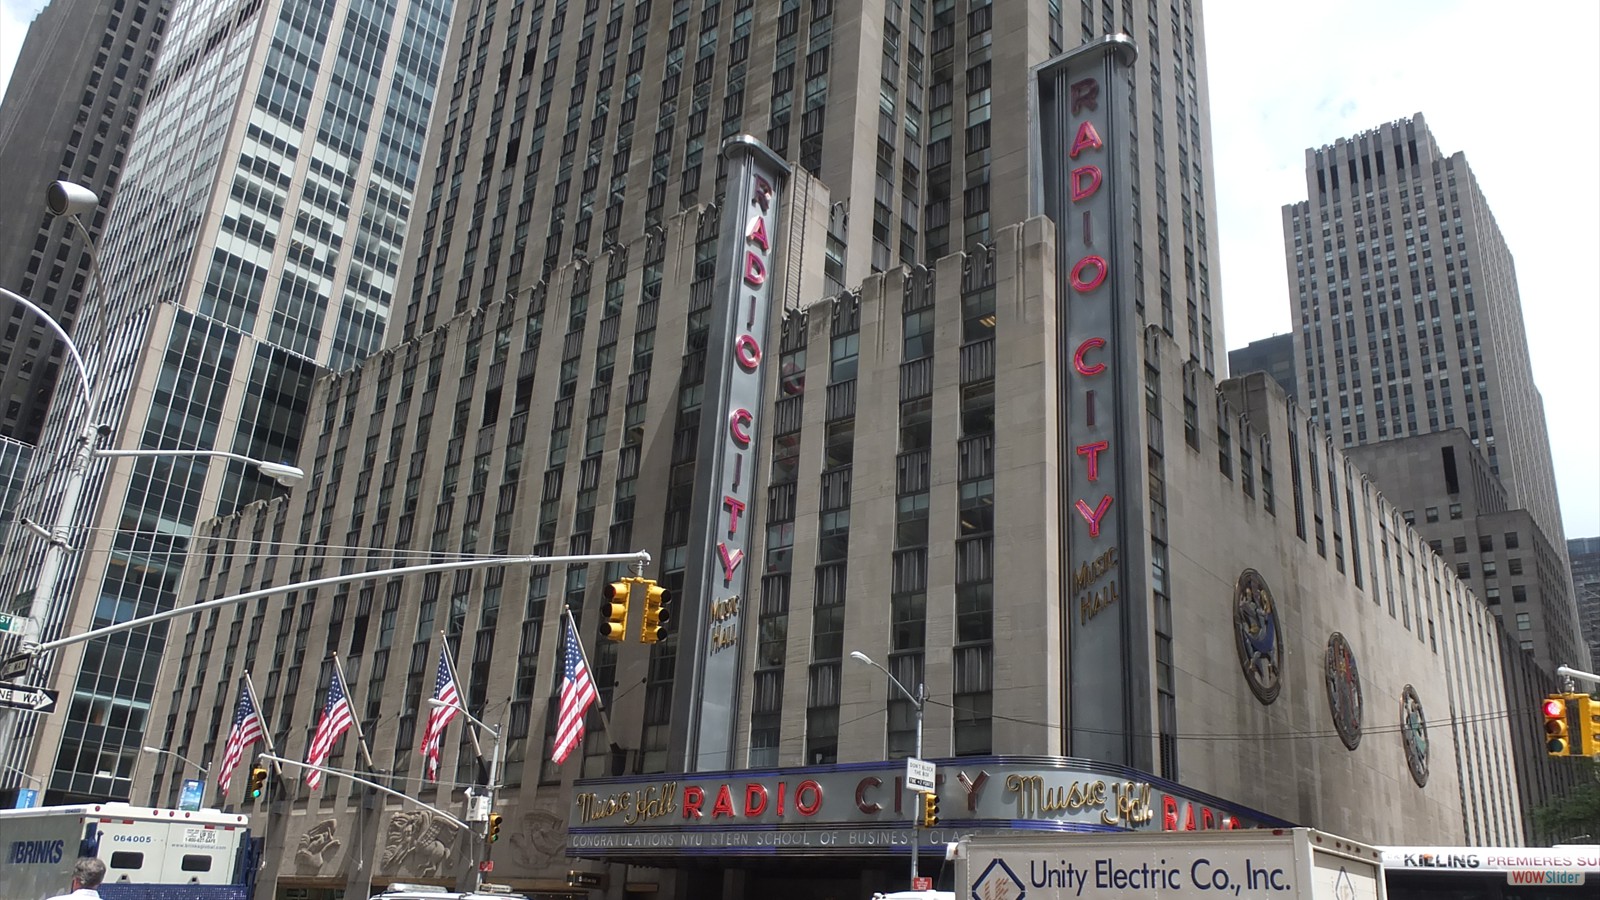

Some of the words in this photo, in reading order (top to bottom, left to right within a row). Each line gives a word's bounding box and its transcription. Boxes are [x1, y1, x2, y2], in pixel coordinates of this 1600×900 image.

[1069, 78, 1108, 293] RADIO
[735, 173, 773, 368] RADIO
[1074, 337, 1113, 537] CITY
[717, 408, 753, 582] CITY
[0, 615, 11, 624] ST
[23, 693, 47, 706] WAY
[577, 791, 631, 823] Music
[624, 781, 679, 825] Hall
[683, 779, 823, 820] RADIO
[855, 770, 990, 815] CIY
[1006, 774, 1107, 815] Music
[1102, 781, 1154, 825] Hall
[15, 839, 65, 864] BRINKS
[113, 834, 152, 844] 064005
[572, 833, 674, 847] CONGRATULATIONS
[681, 833, 703, 846] NYU
[711, 832, 749, 846] STERN
[757, 830, 810, 846] SCHOOL
[820, 830, 838, 845] OF
[849, 830, 914, 845] BUSINES
[1030, 859, 1088, 897] Unity
[1095, 858, 1181, 890] Electric
[1190, 858, 1241, 897] Co.,
[1246, 859, 1291, 891] Inc.
[1487, 856, 1572, 867] PREMIERES
